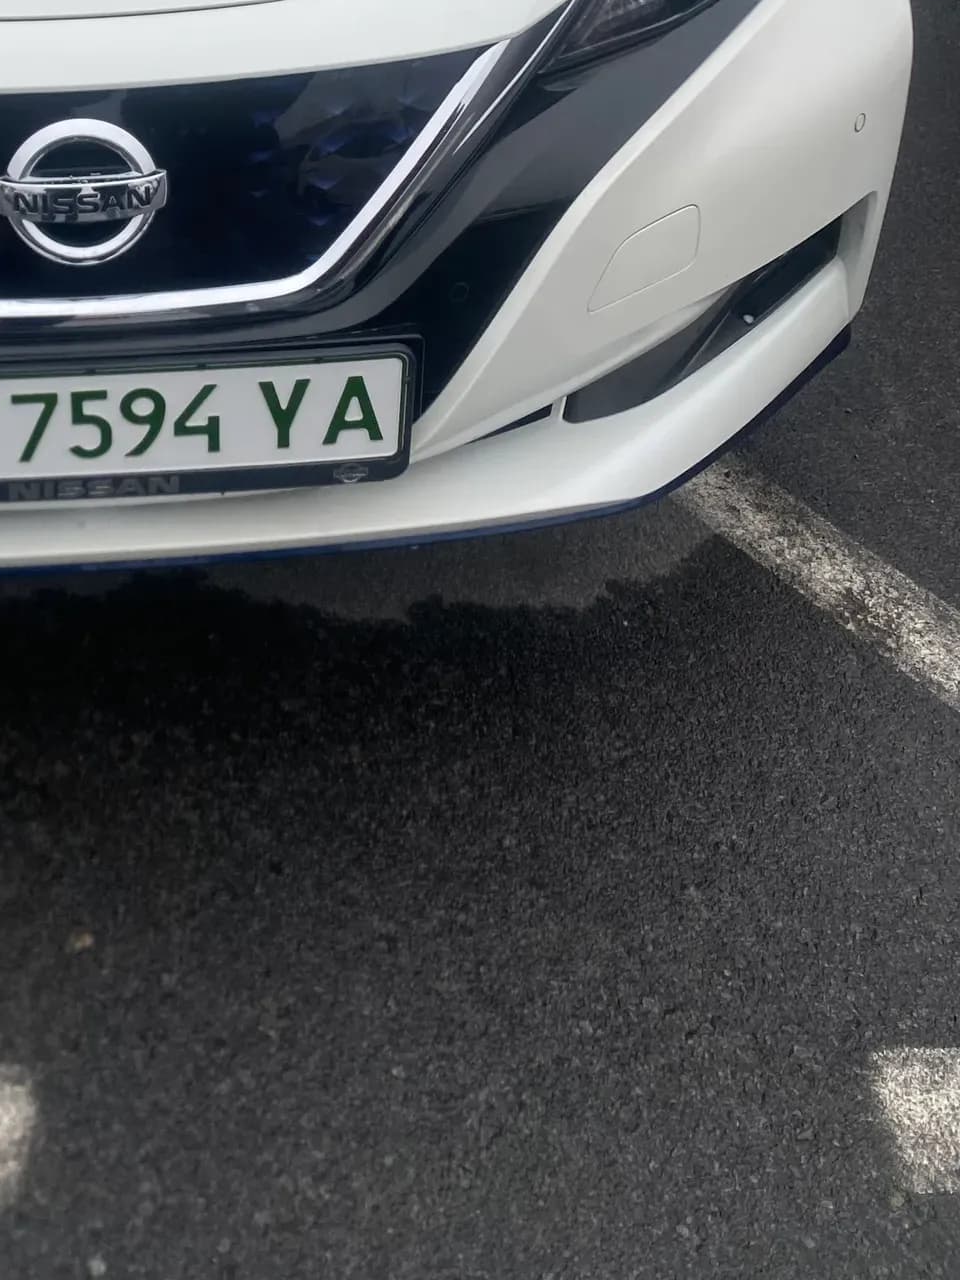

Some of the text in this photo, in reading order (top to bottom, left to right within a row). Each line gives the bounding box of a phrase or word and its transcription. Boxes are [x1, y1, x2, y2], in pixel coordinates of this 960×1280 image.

[12, 185, 152, 215] NISSAN
[10, 383, 221, 463] 7594
[258, 375, 384, 450] YA
[8, 475, 180, 502] NISSAN
